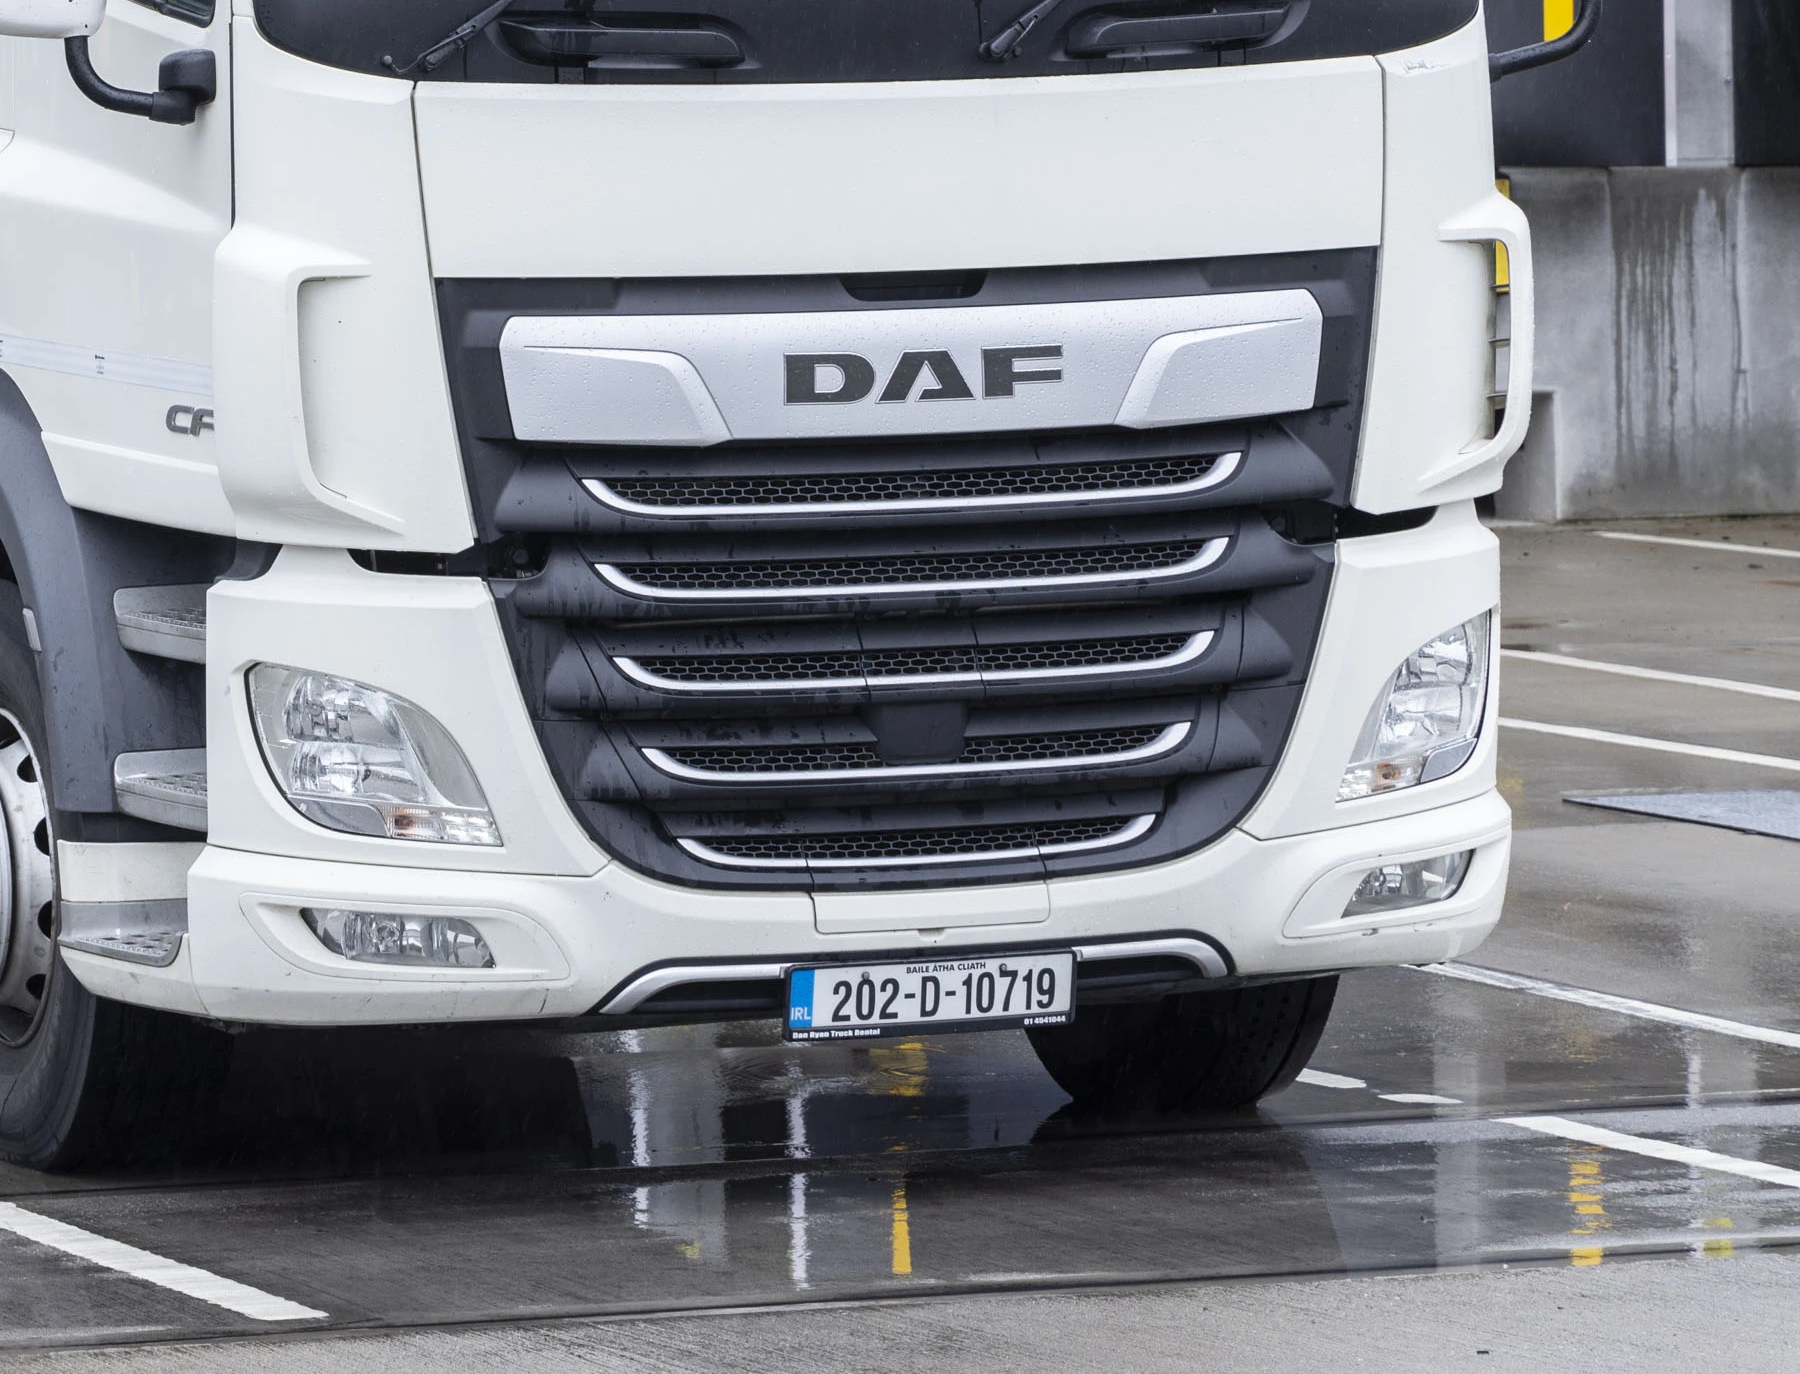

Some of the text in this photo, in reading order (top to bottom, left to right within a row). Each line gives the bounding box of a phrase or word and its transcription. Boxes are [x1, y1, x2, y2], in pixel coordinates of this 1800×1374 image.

[783, 343, 1063, 406] DAF
[905, 961, 986, 974] BAILE ÁTHA CLIATH
[790, 967, 1056, 1023] IRL 202-D-10719
[792, 1031, 808, 1039] Dan
[830, 1029, 853, 1037] Truck
[854, 1028, 880, 1036] Rental
